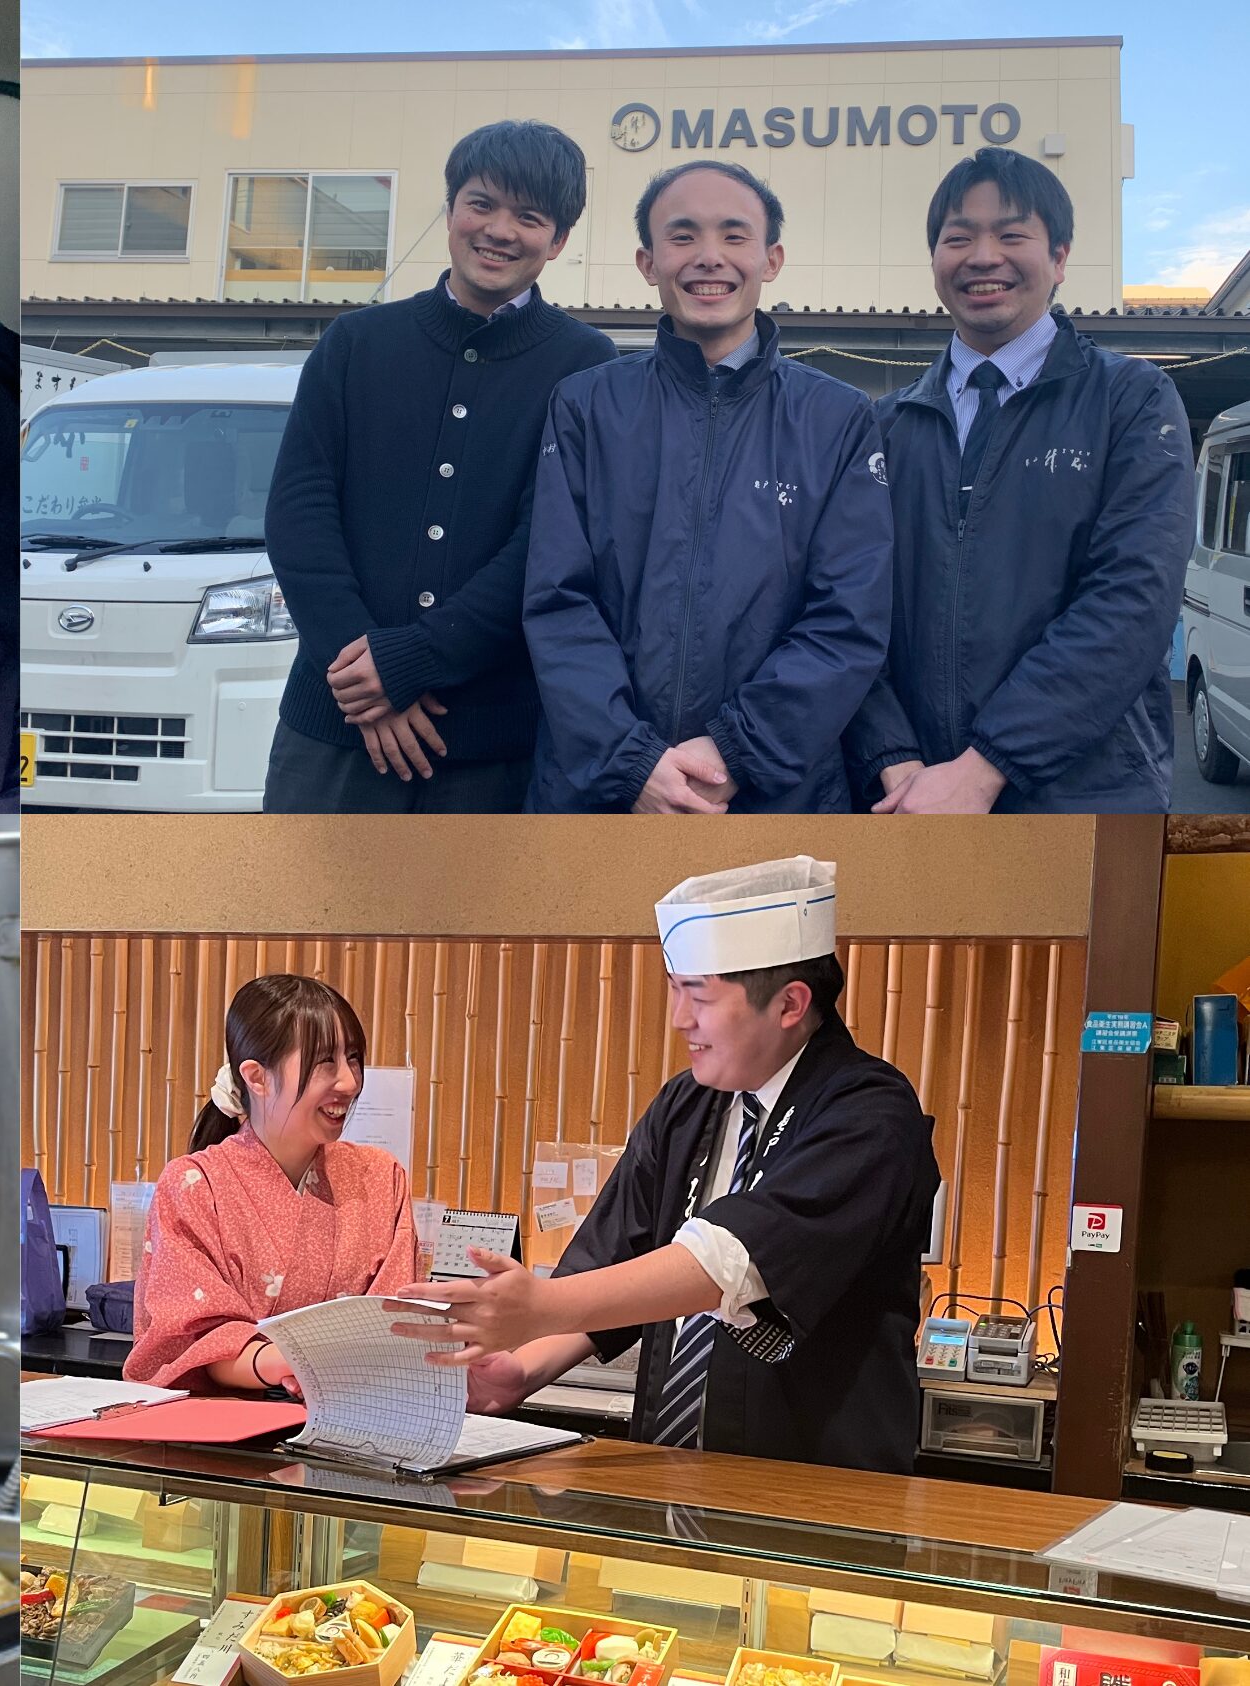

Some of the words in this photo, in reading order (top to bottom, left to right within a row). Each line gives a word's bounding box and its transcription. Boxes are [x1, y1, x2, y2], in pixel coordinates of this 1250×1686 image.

[671, 102, 1022, 149] MASUMOTO
[1081, 1231, 1110, 1240] PayPay
[938, 1402, 959, 1416] Fits
[218, 1609, 254, 1654] すみだ川
